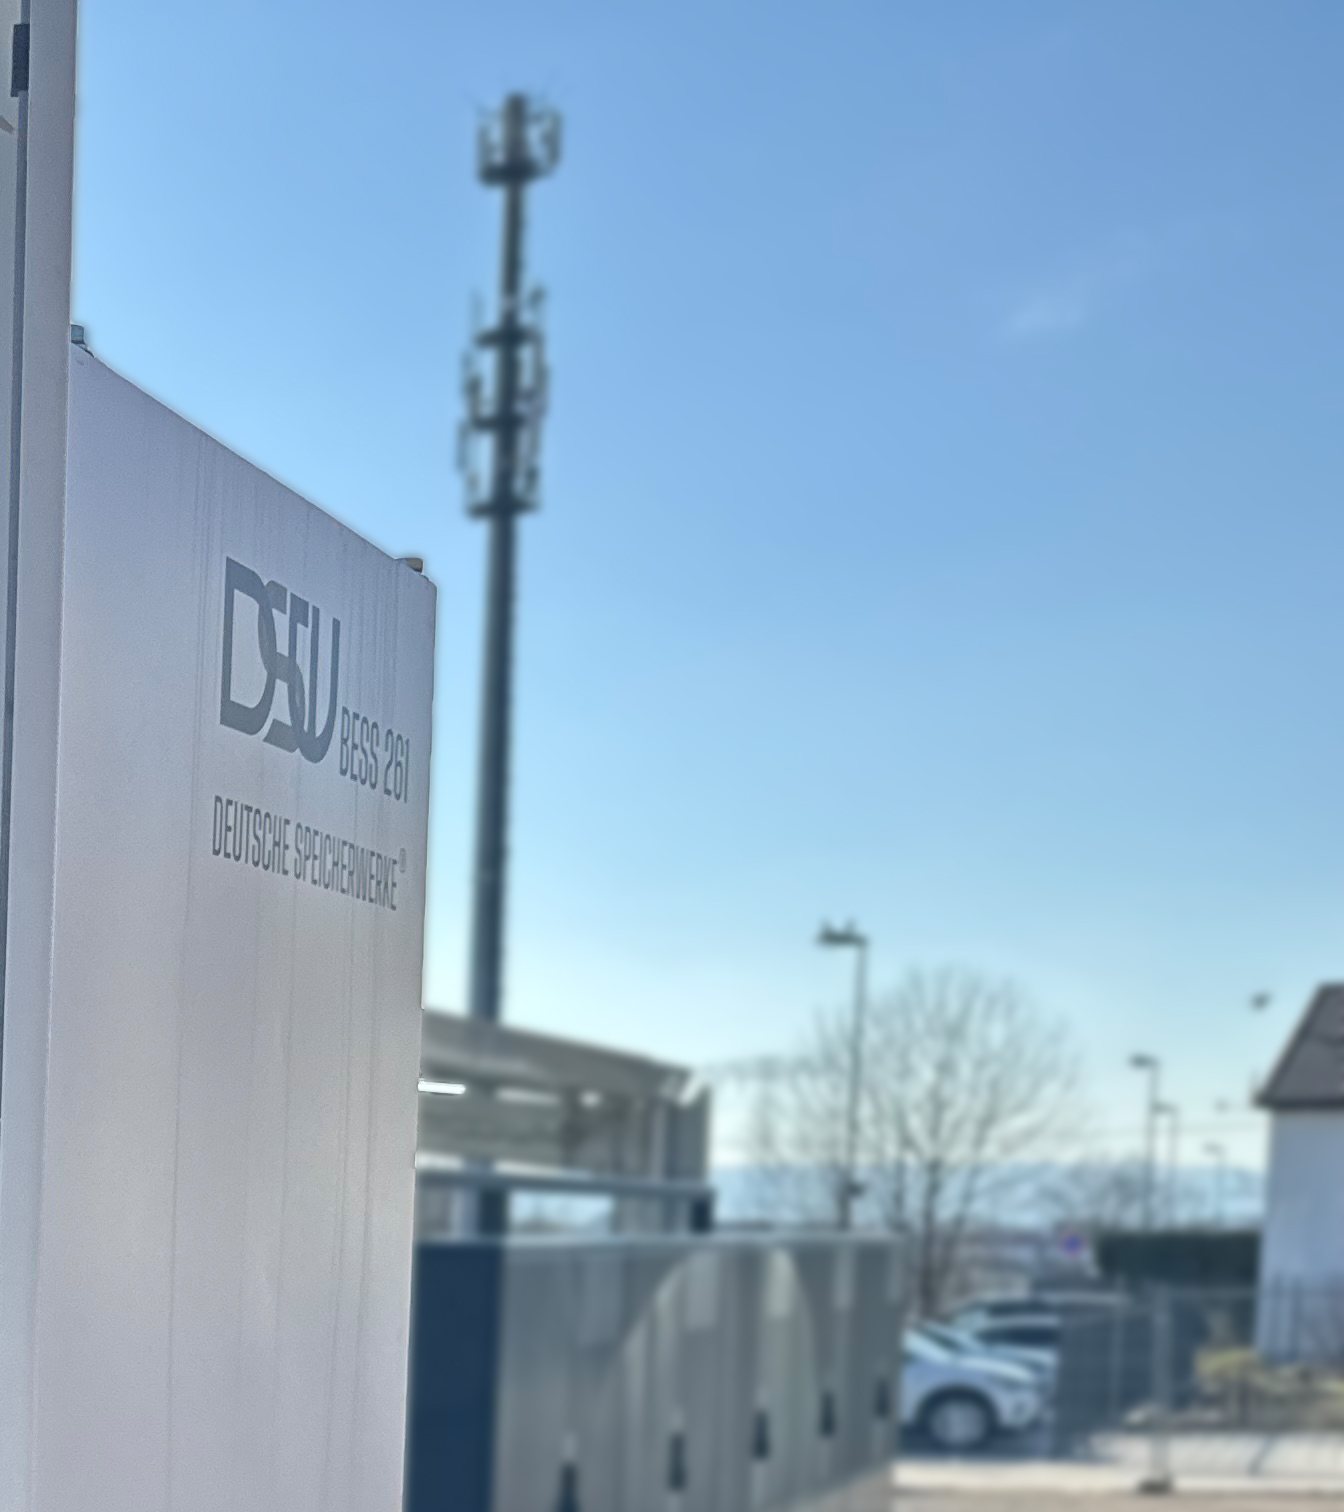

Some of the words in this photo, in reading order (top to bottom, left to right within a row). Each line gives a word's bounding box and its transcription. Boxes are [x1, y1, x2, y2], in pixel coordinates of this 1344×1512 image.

[339, 706, 378, 791] BESS
[383, 729, 409, 803] 261
[212, 795, 290, 876] DEUTSCHE
